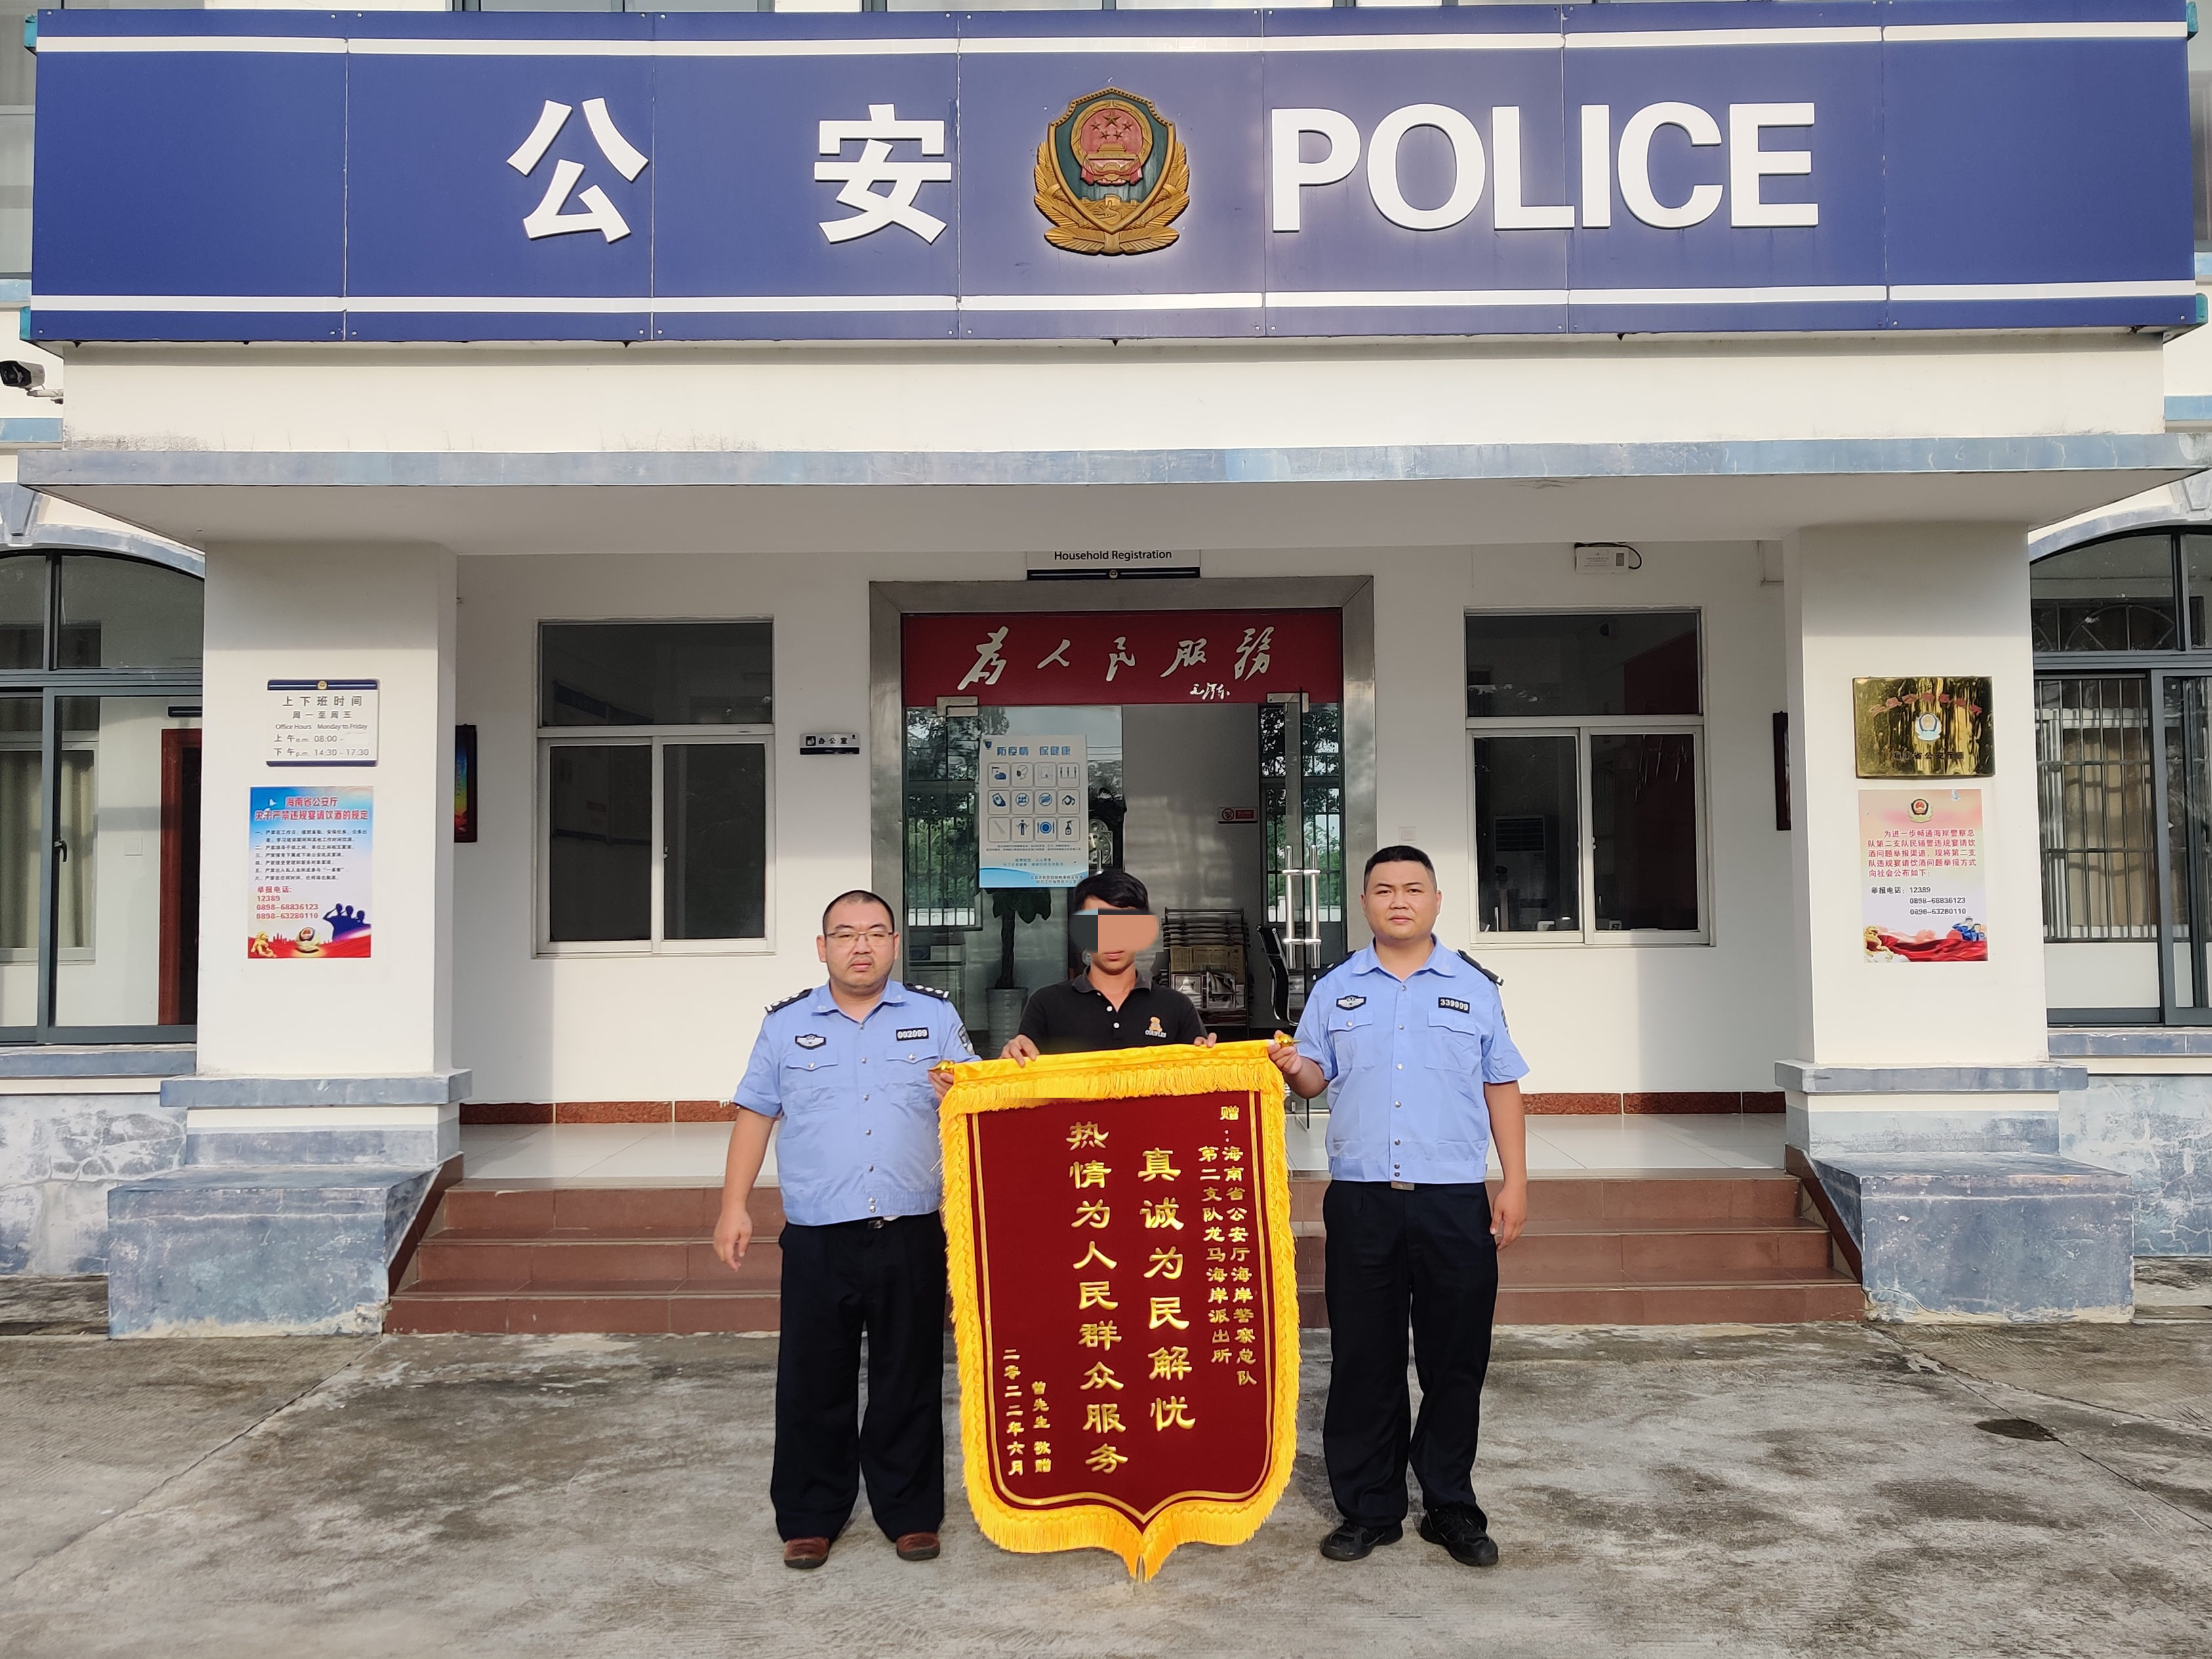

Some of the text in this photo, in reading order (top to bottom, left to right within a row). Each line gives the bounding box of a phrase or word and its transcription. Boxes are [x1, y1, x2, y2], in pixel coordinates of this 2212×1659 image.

[507, 97, 1819, 243] 公安 POLICE
[1054, 550, 1172, 561] Household Registration
[283, 696, 362, 706] 上下班时间
[274, 748, 295, 756] 下午
[286, 797, 338, 807] 海南省公安厅
[1869, 858, 1977, 867] 队违规宴请饮酒问题举报方式
[1138, 1147, 1196, 1431] 真诚为民解忧
[1198, 1146, 1232, 1364] 第二支队龙马海岸派出所
[1066, 1121, 1129, 1475] 热情为人民群众服务
[1003, 1349, 1025, 1475] 二零二二年六月
